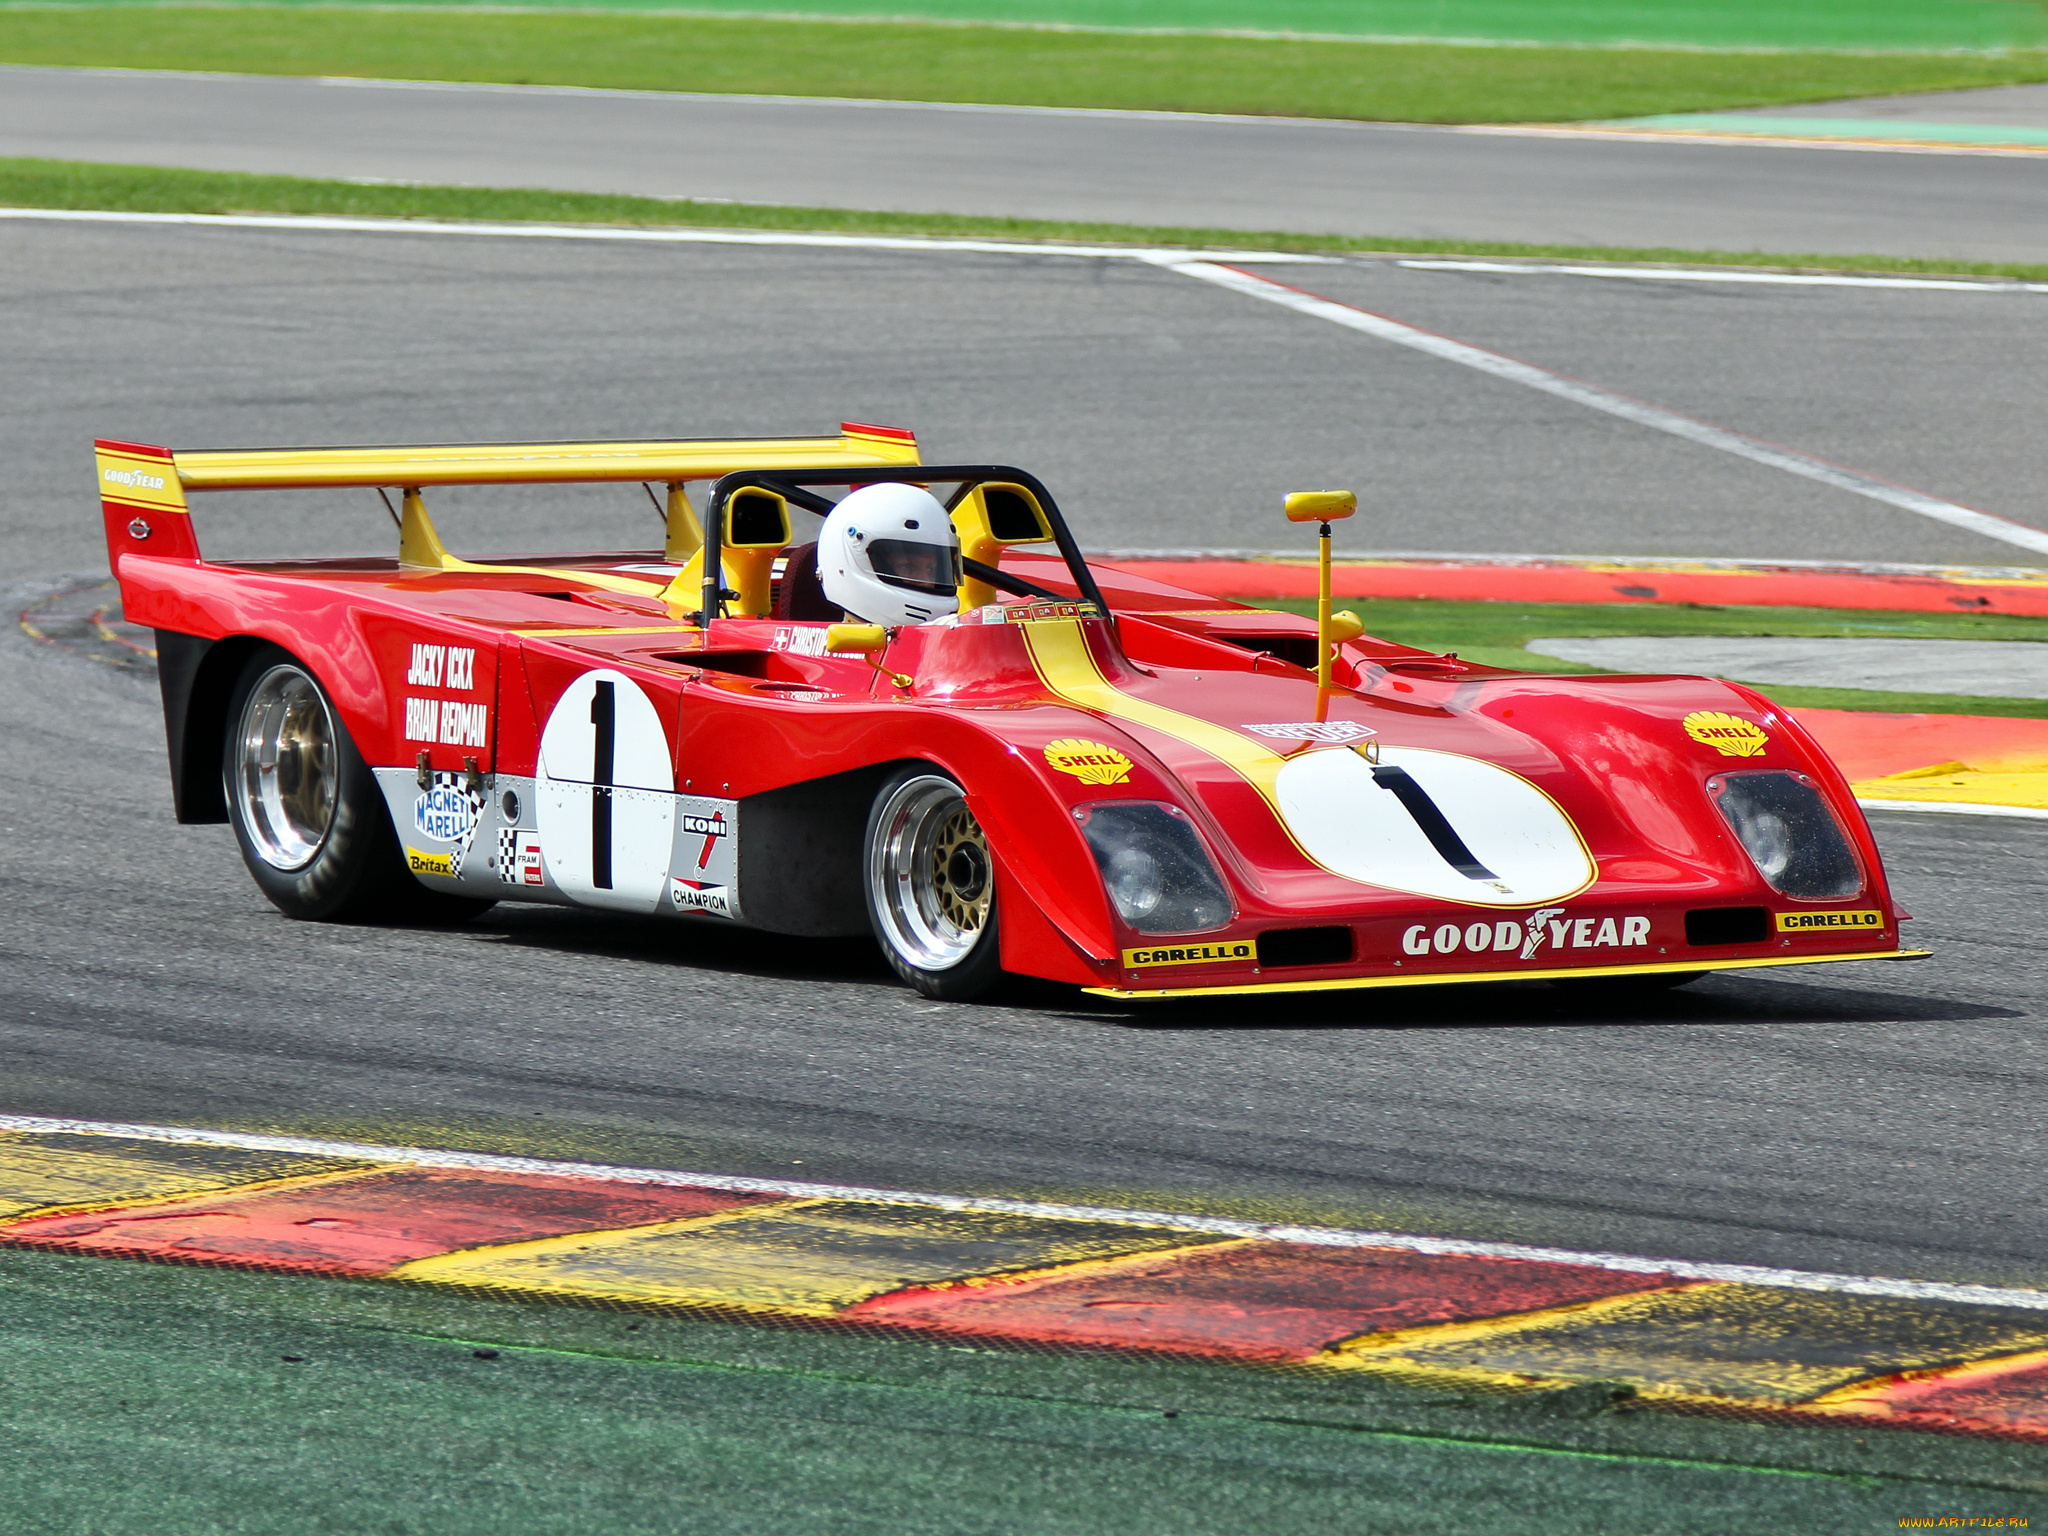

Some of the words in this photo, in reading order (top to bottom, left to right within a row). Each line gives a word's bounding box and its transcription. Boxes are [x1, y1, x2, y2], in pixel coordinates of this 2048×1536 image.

[787, 626, 831, 657] CHRISTOP
[408, 643, 446, 687] JACKY
[446, 646, 475, 690] ICKX
[406, 697, 439, 743] BRIAN
[440, 701, 487, 748] REDMAN
[1697, 727, 1757, 738] SHELL
[1257, 726, 1368, 741] HEUER
[1058, 754, 1121, 767] SHELL
[591, 680, 615, 889] 1
[417, 791, 468, 814] MAGNETI
[417, 814, 468, 837] MARELLI
[685, 817, 726, 835] KONI
[1369, 766, 1501, 880] 1
[410, 856, 450, 874] Britax
[517, 855, 537, 863] FRAM
[673, 890, 727, 911] CHAMPION
[1784, 914, 1878, 928] CARELLO
[1132, 945, 1250, 964] CARELLO
